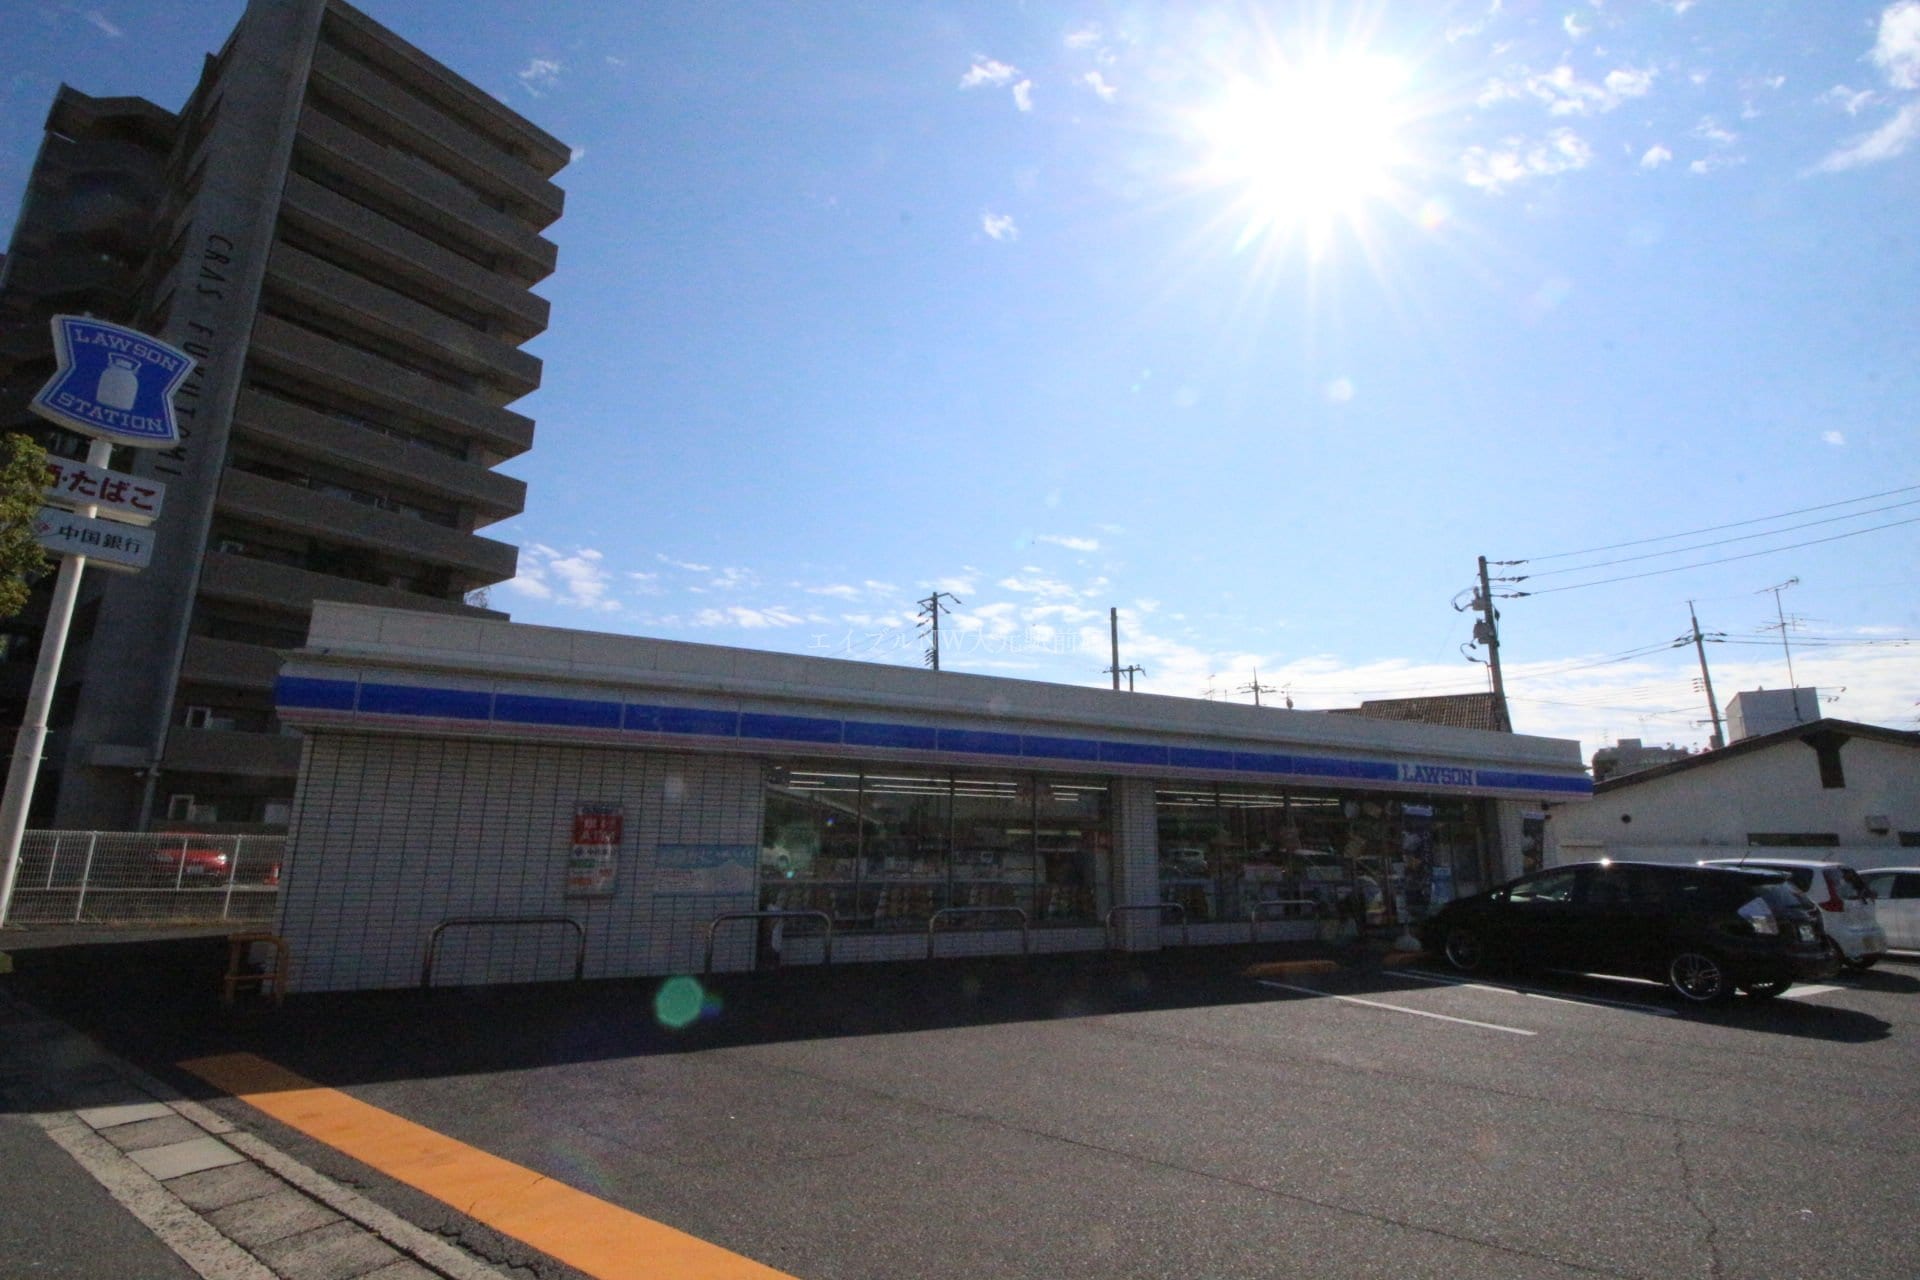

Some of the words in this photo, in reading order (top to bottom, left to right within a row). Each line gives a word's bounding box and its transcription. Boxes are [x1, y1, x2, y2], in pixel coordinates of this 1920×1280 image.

[196, 233, 234, 300] CRAS
[73, 328, 179, 372] LAWSON
[56, 392, 164, 432] STATION
[59, 525, 141, 553] 中国銀行
[1401, 763, 1473, 786] LAWSON
